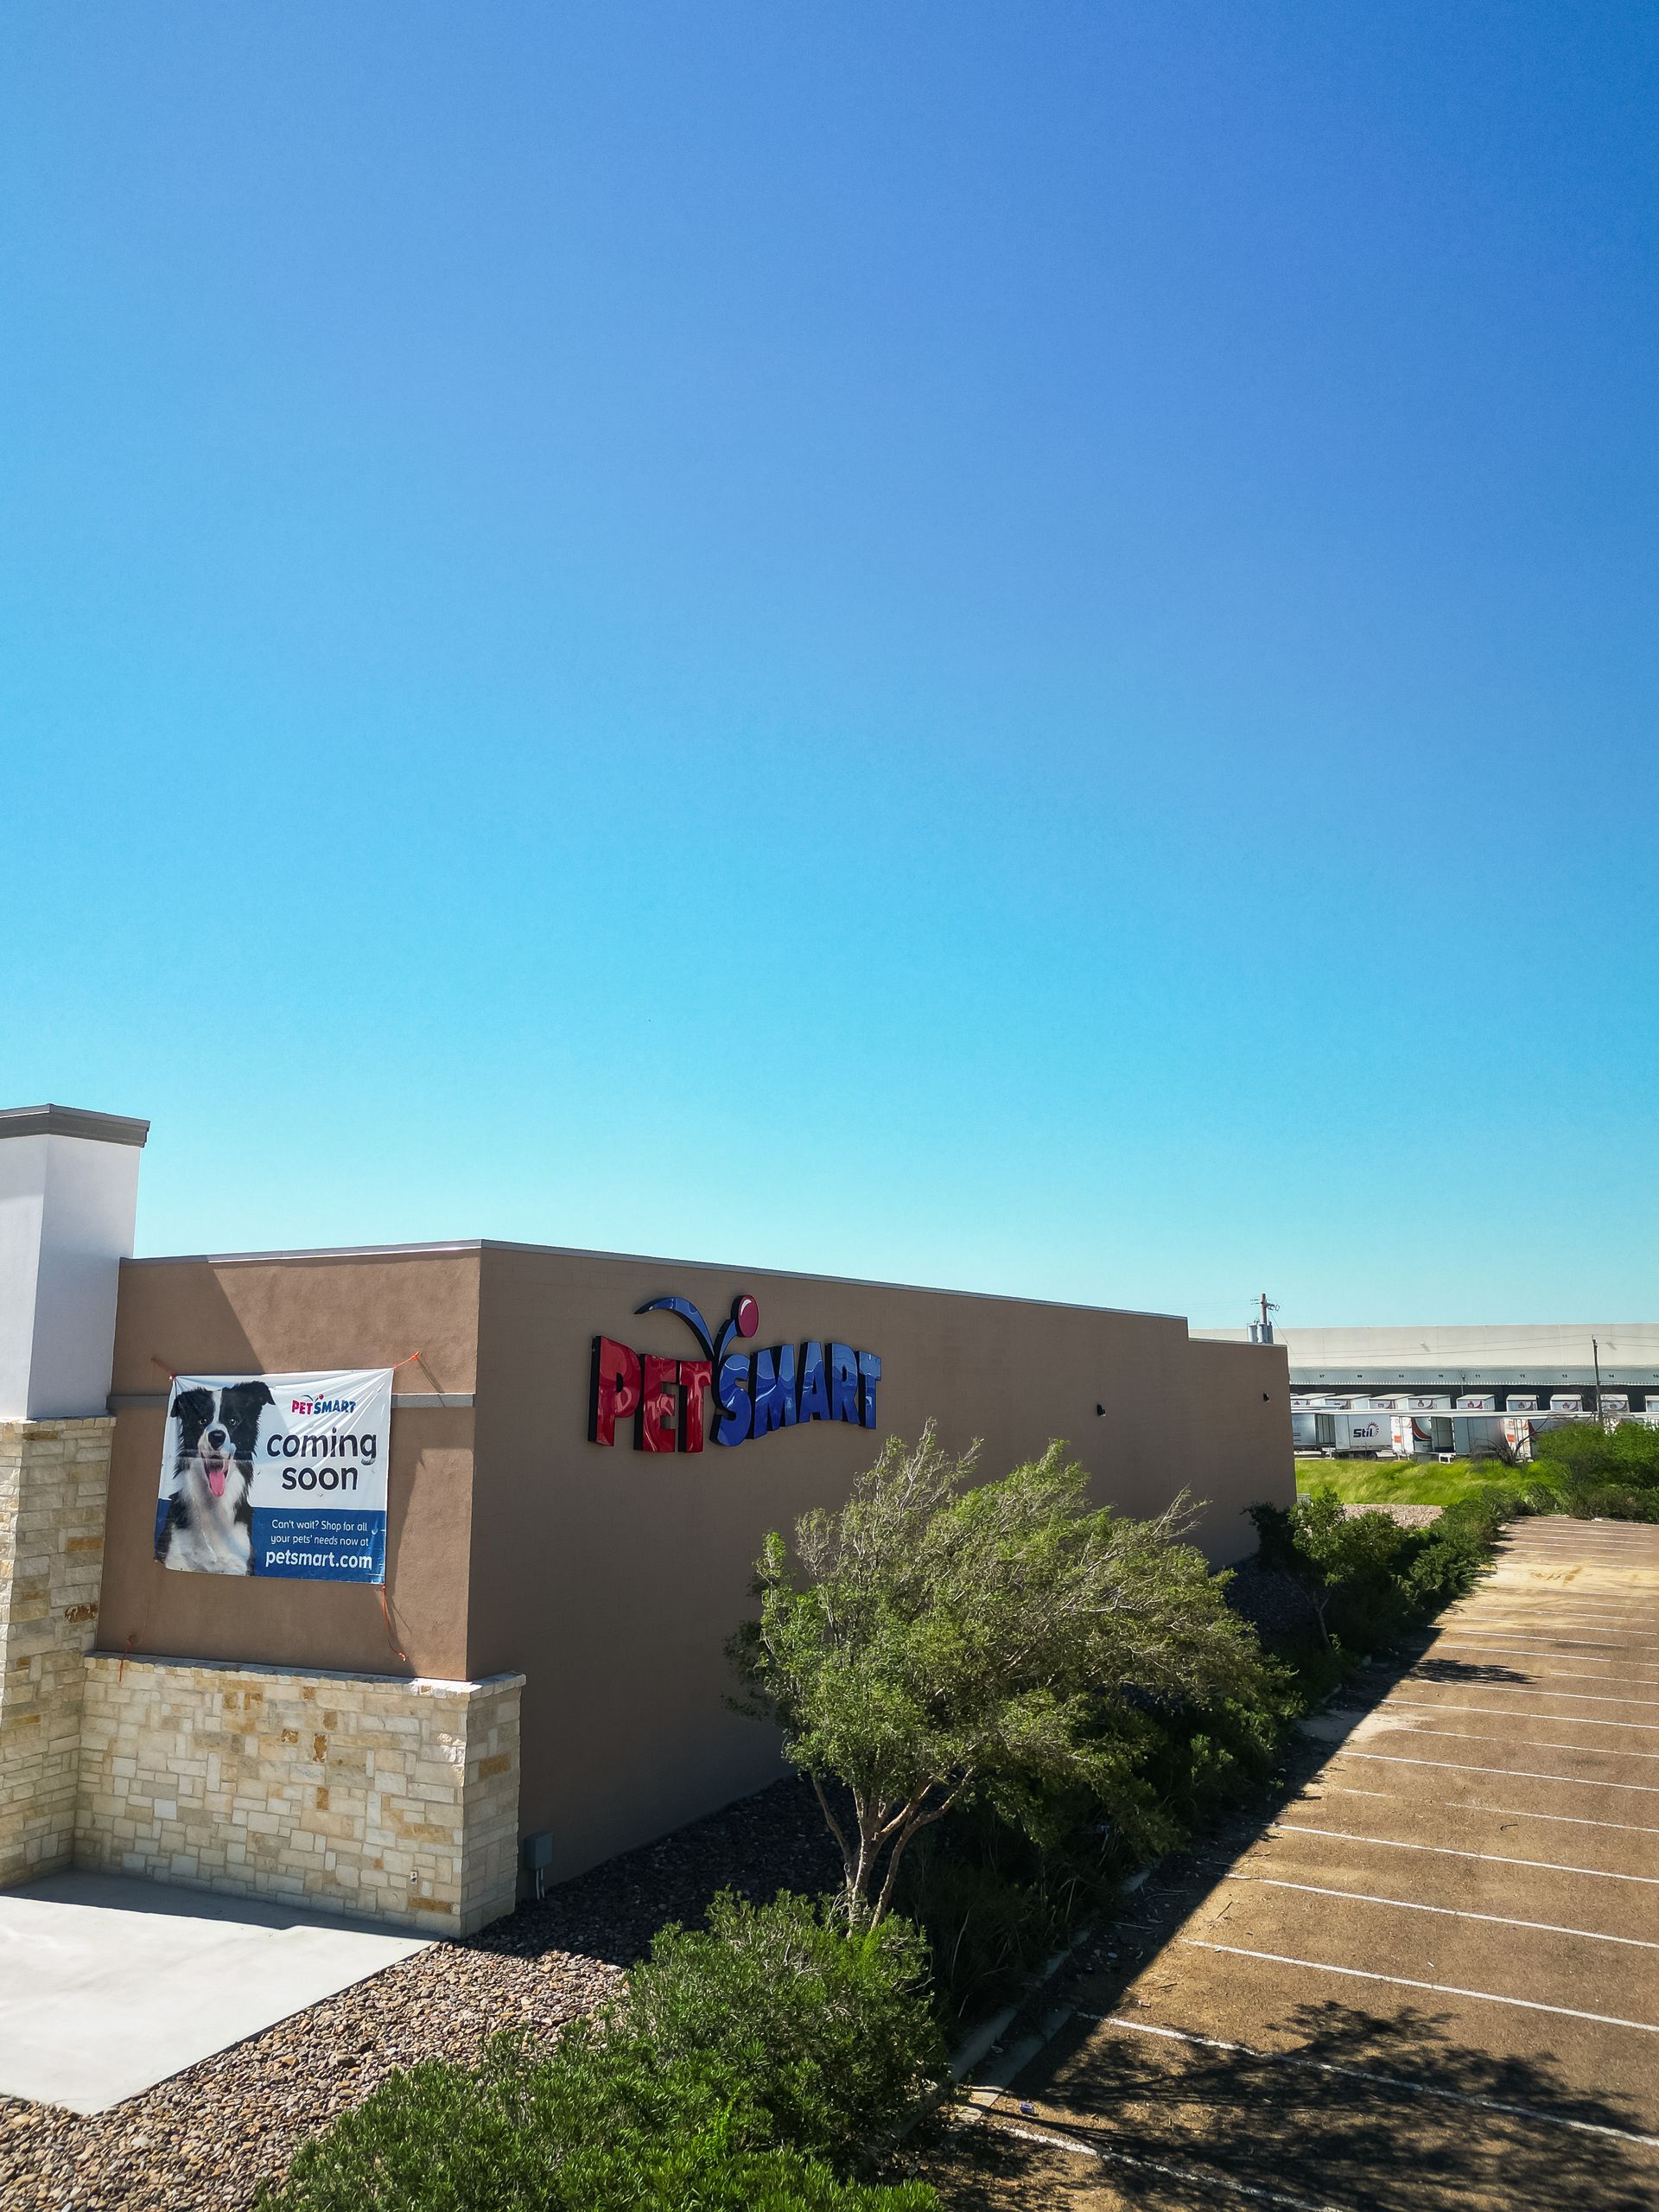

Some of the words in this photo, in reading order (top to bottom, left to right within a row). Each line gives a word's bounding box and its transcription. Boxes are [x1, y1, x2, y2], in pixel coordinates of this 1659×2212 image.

[588, 1335, 882, 1453] PETSMART
[291, 1399, 356, 1415] PETSMART
[266, 1427, 377, 1466] coming
[282, 1467, 359, 1491] soon
[271, 1519, 295, 1529] Can't
[296, 1520, 319, 1529] wait?
[321, 1521, 342, 1533] Shop
[343, 1522, 355, 1531] for
[357, 1522, 367, 1532] all
[270, 1535, 290, 1545] your
[292, 1535, 313, 1545] pets'
[314, 1535, 338, 1546] needs
[340, 1538, 359, 1547] now
[360, 1538, 369, 1547] at
[264, 1548, 373, 1571] petsmart.com
